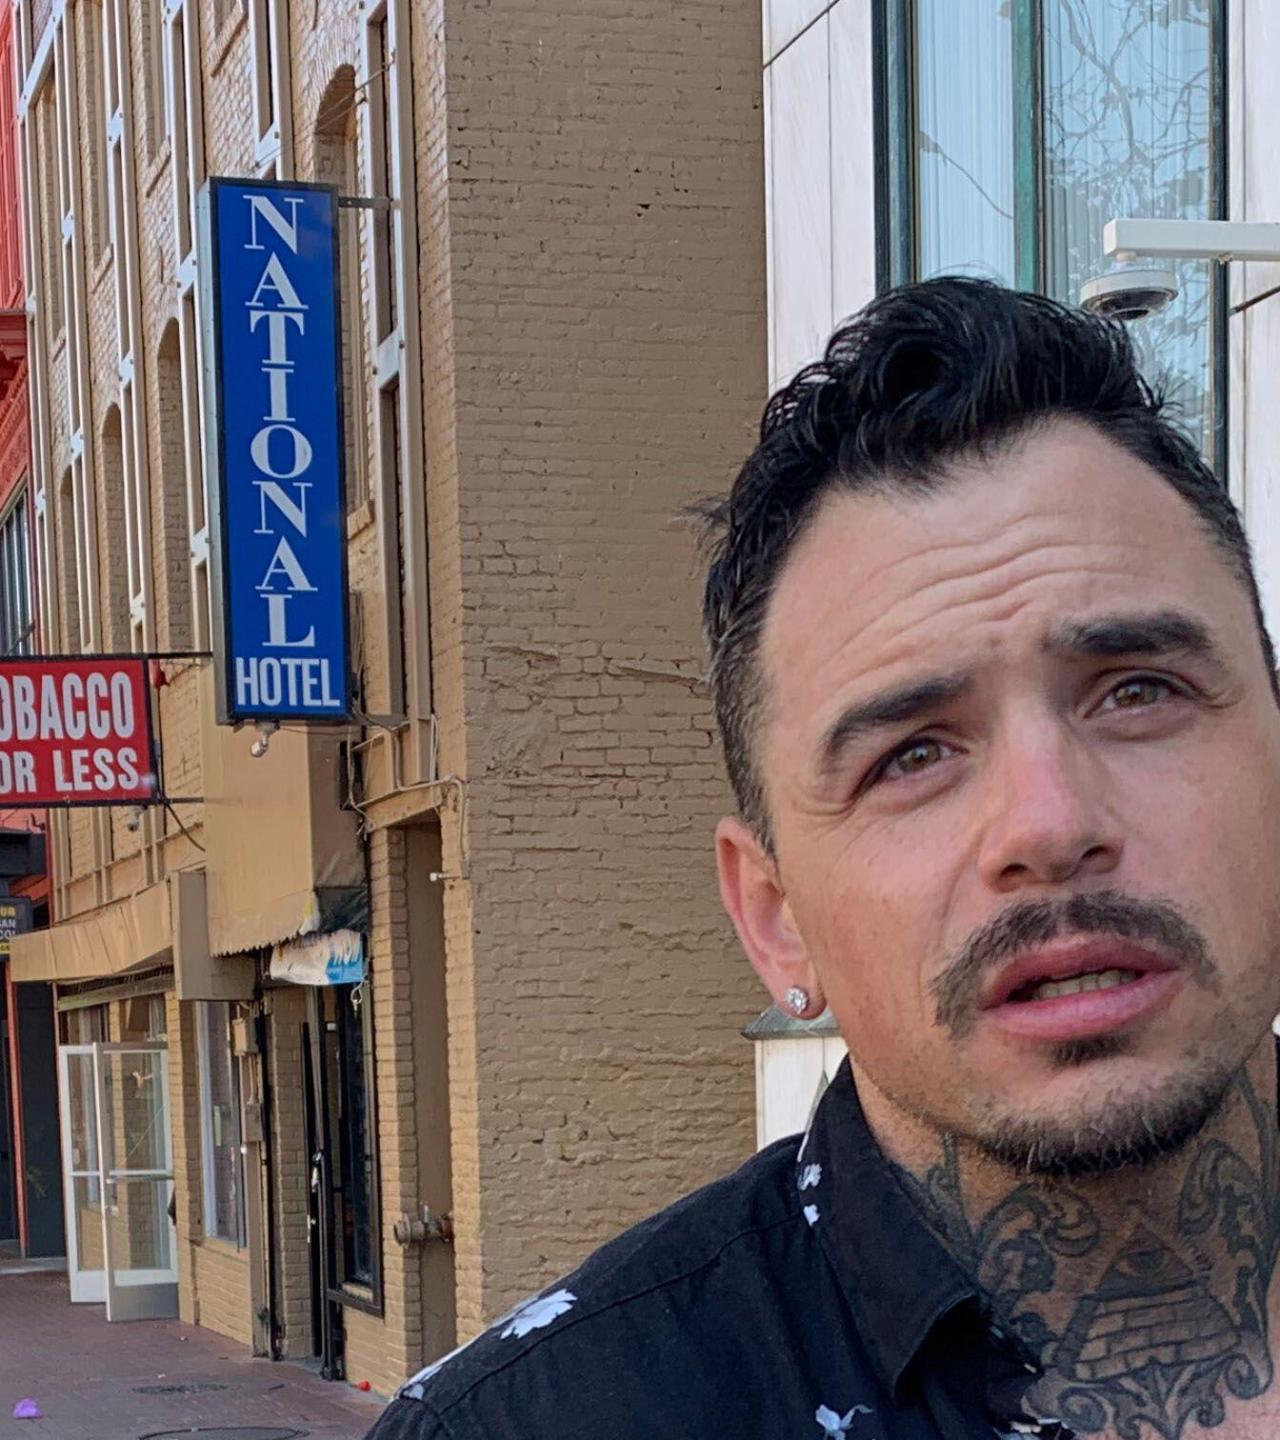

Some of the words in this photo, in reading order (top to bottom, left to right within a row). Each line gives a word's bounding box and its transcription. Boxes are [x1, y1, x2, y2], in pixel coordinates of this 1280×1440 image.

[243, 195, 318, 648] NATIONAL
[235, 656, 341, 707] HOTEL
[52, 747, 139, 792] LESS
